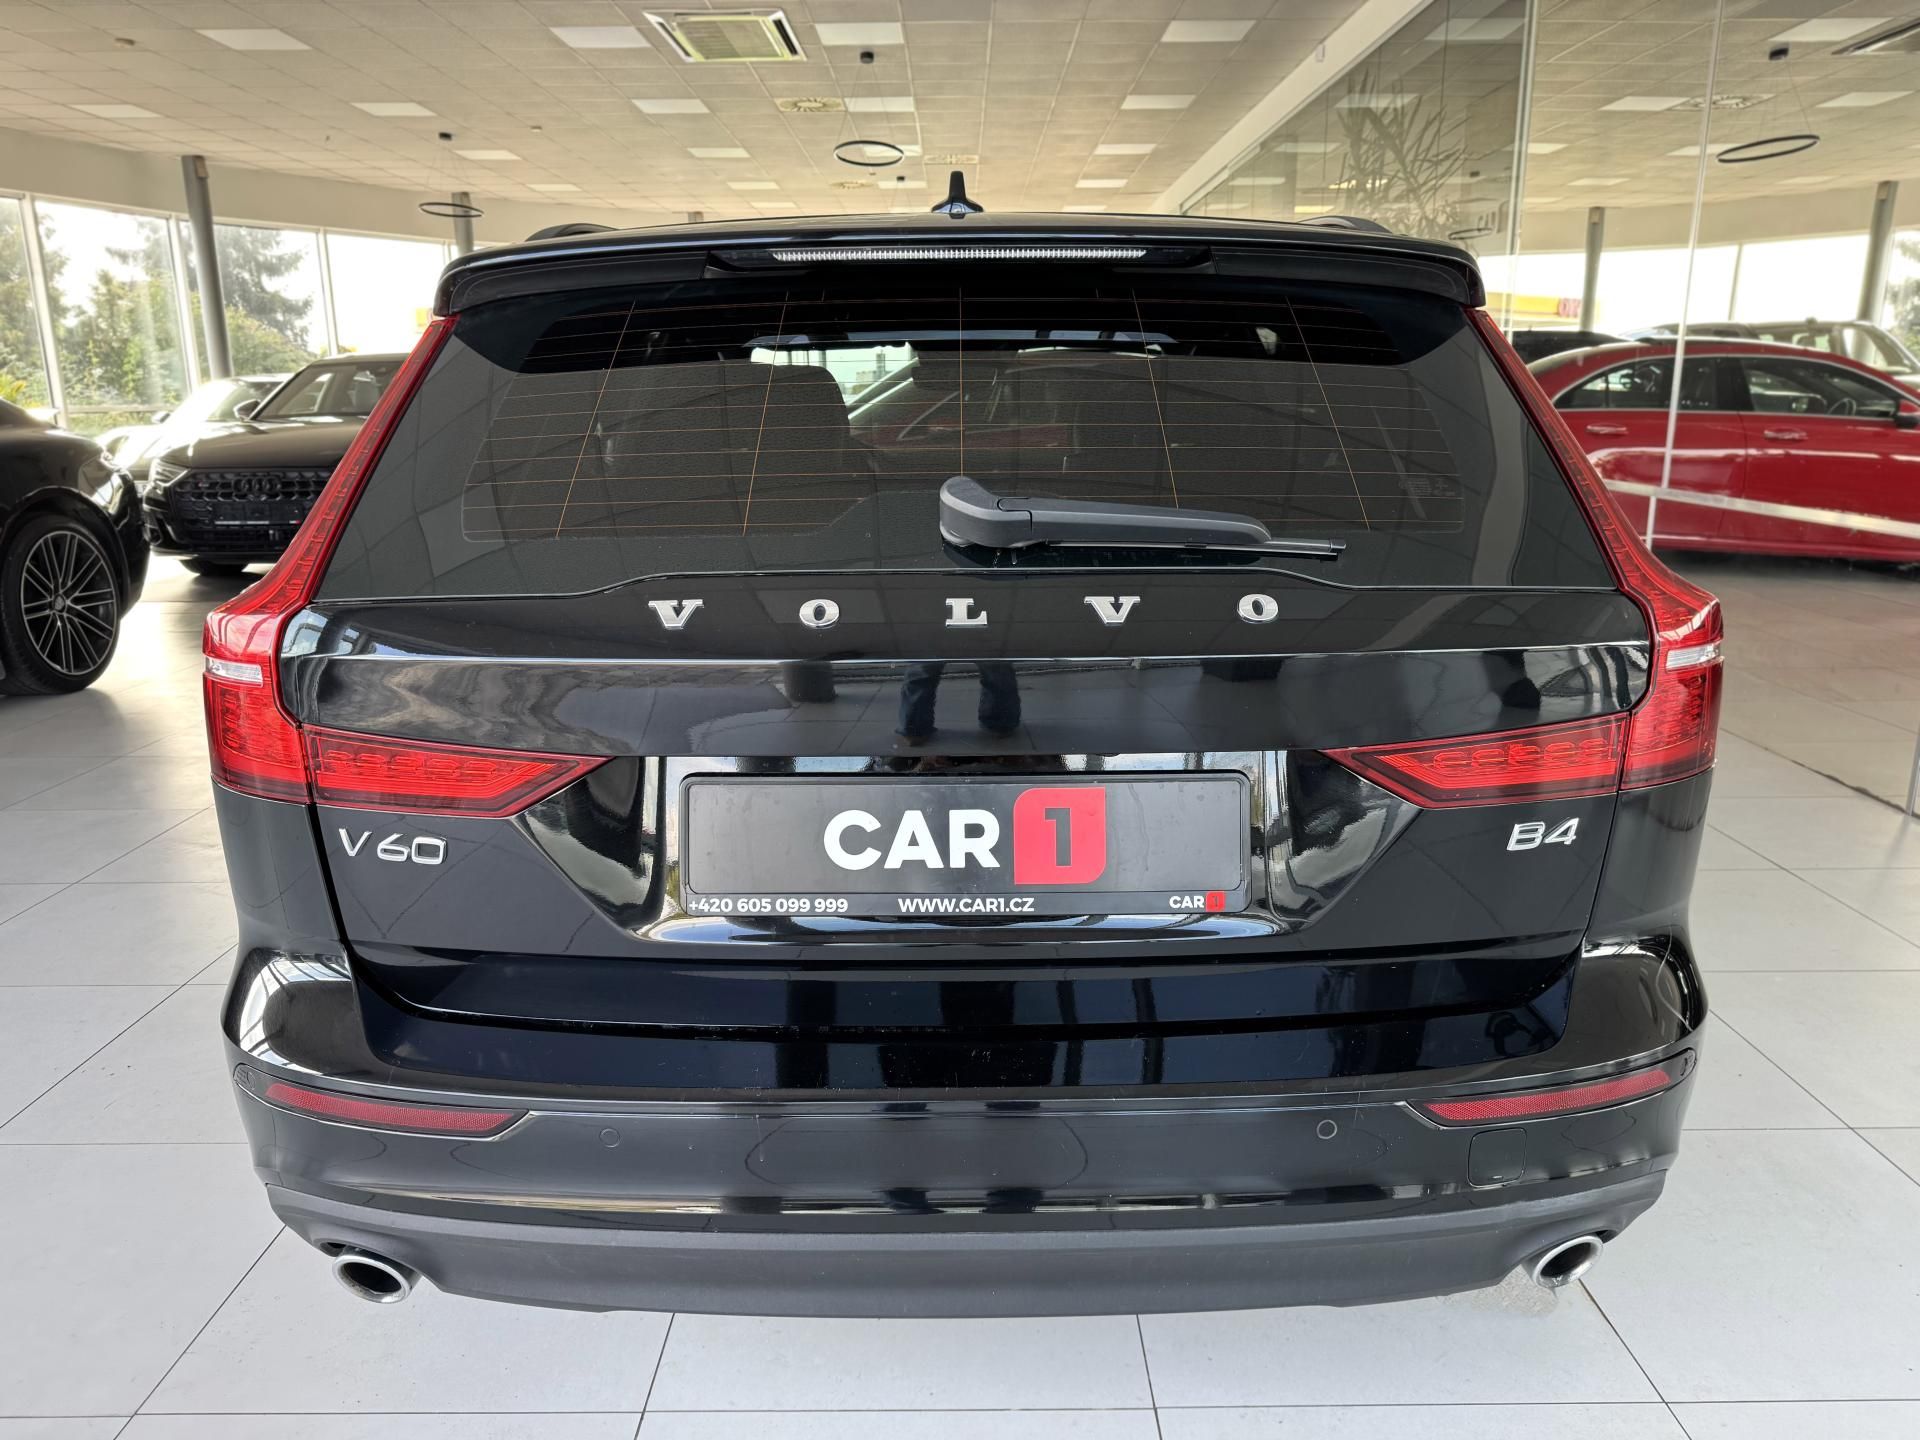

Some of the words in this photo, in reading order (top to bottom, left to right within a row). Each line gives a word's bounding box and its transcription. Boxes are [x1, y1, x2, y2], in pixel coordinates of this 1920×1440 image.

[648, 593, 1279, 629] VOLVO
[1506, 817, 1579, 851] B4
[689, 898, 733, 913] +420
[737, 898, 772, 913] 605
[775, 898, 811, 913] 099
[814, 898, 848, 913] 999
[898, 897, 1035, 913] WWW.CAR1.CZ
